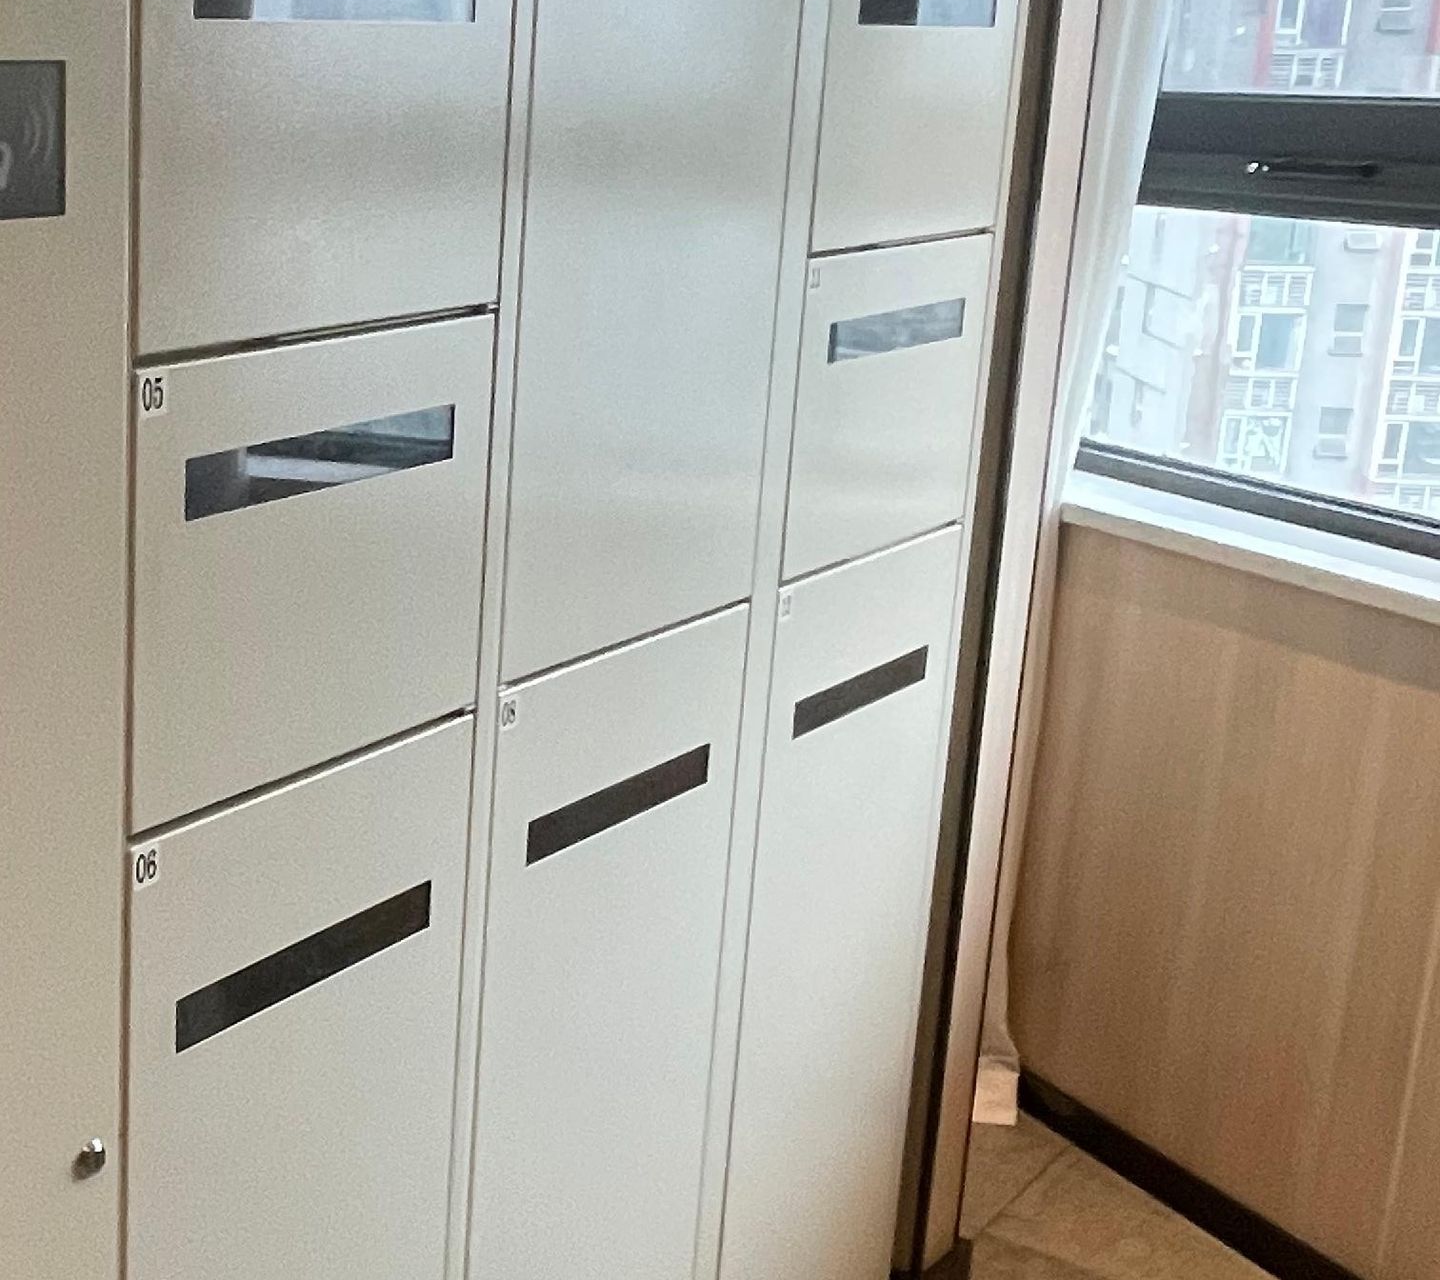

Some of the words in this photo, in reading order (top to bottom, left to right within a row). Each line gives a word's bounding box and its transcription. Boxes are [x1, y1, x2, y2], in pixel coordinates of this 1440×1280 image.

[141, 376, 164, 412] 05
[501, 699, 517, 728] 08
[135, 848, 158, 884] 06
